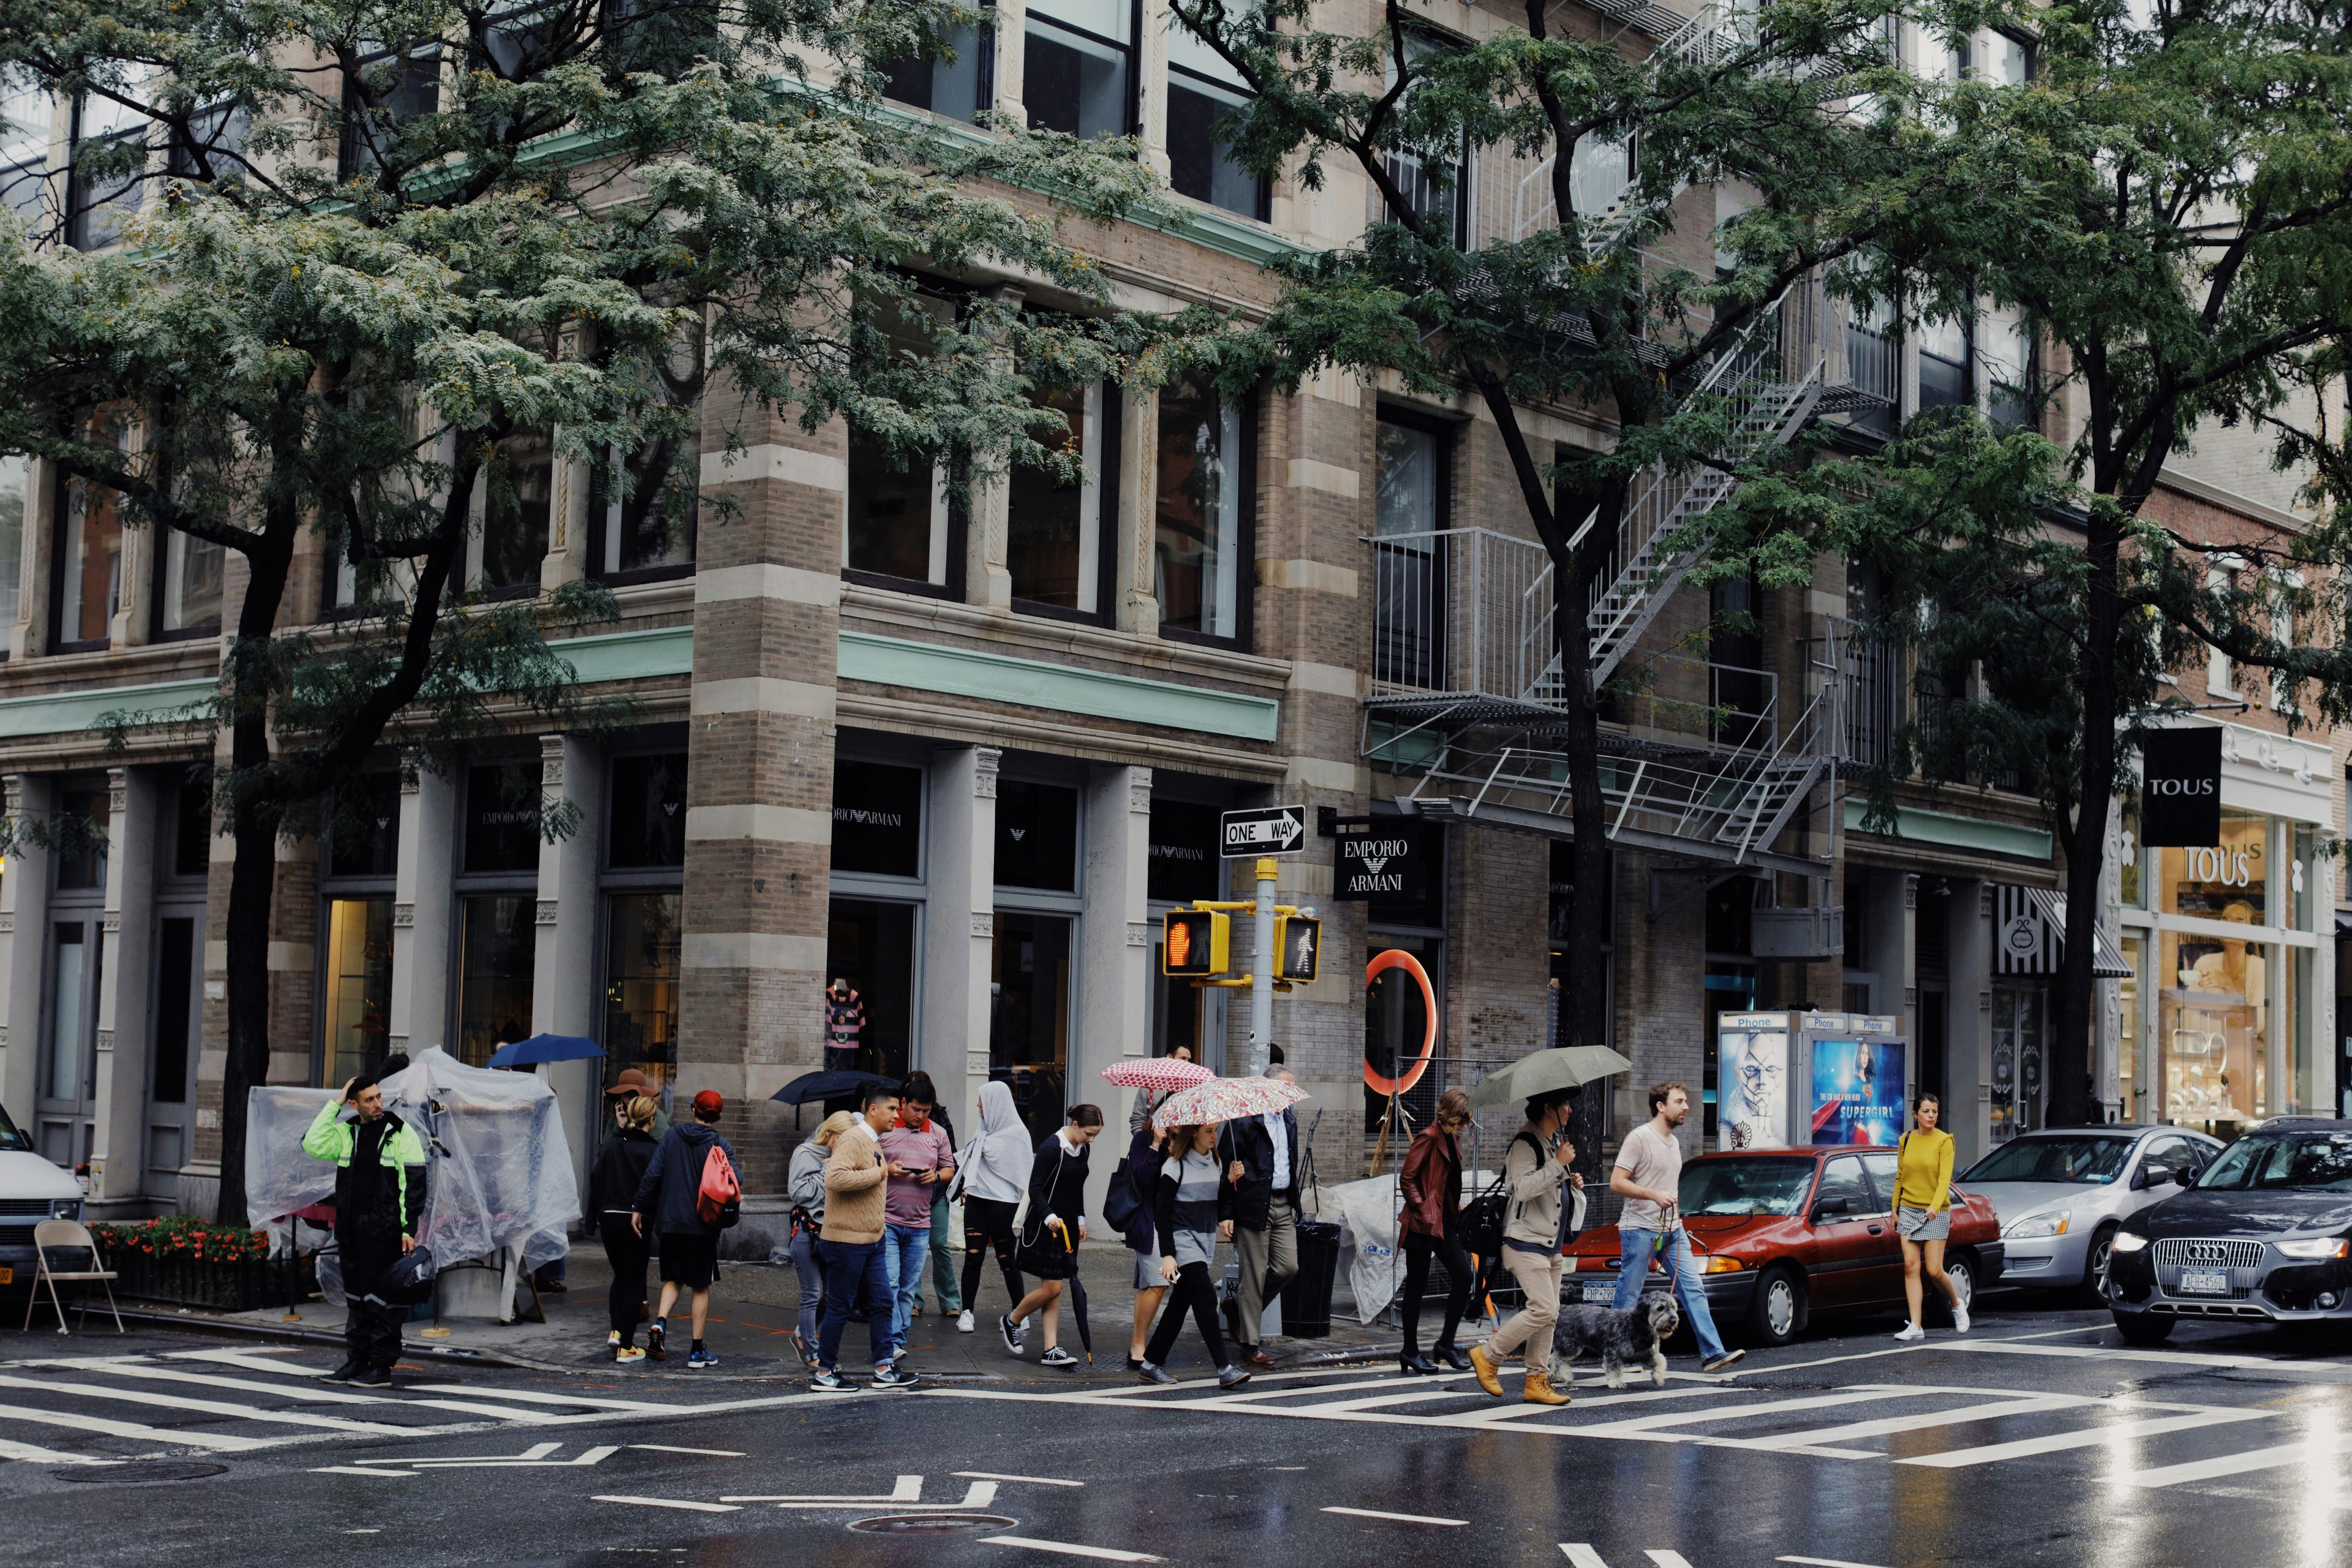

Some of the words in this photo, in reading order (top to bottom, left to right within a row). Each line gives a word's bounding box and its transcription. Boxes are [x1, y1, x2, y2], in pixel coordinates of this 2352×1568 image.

[2149, 778, 2214, 796] TOUS
[483, 811, 519, 824] EMPORIO
[865, 811, 901, 827] ARMANI
[1229, 824, 1256, 842] ONE
[1271, 821, 1295, 839] WAY
[1174, 846, 1203, 861] ARMANI
[1344, 839, 1408, 858] EMPORIO
[2184, 846, 2249, 888] TOUS
[1348, 874, 1402, 891] ARMANI
[1738, 1019, 1771, 1028] Phone
[1814, 1018, 1834, 1028] Phone
[1864, 1019, 1882, 1030] Phone
[1840, 1106, 1894, 1119] SUPERGIRL
